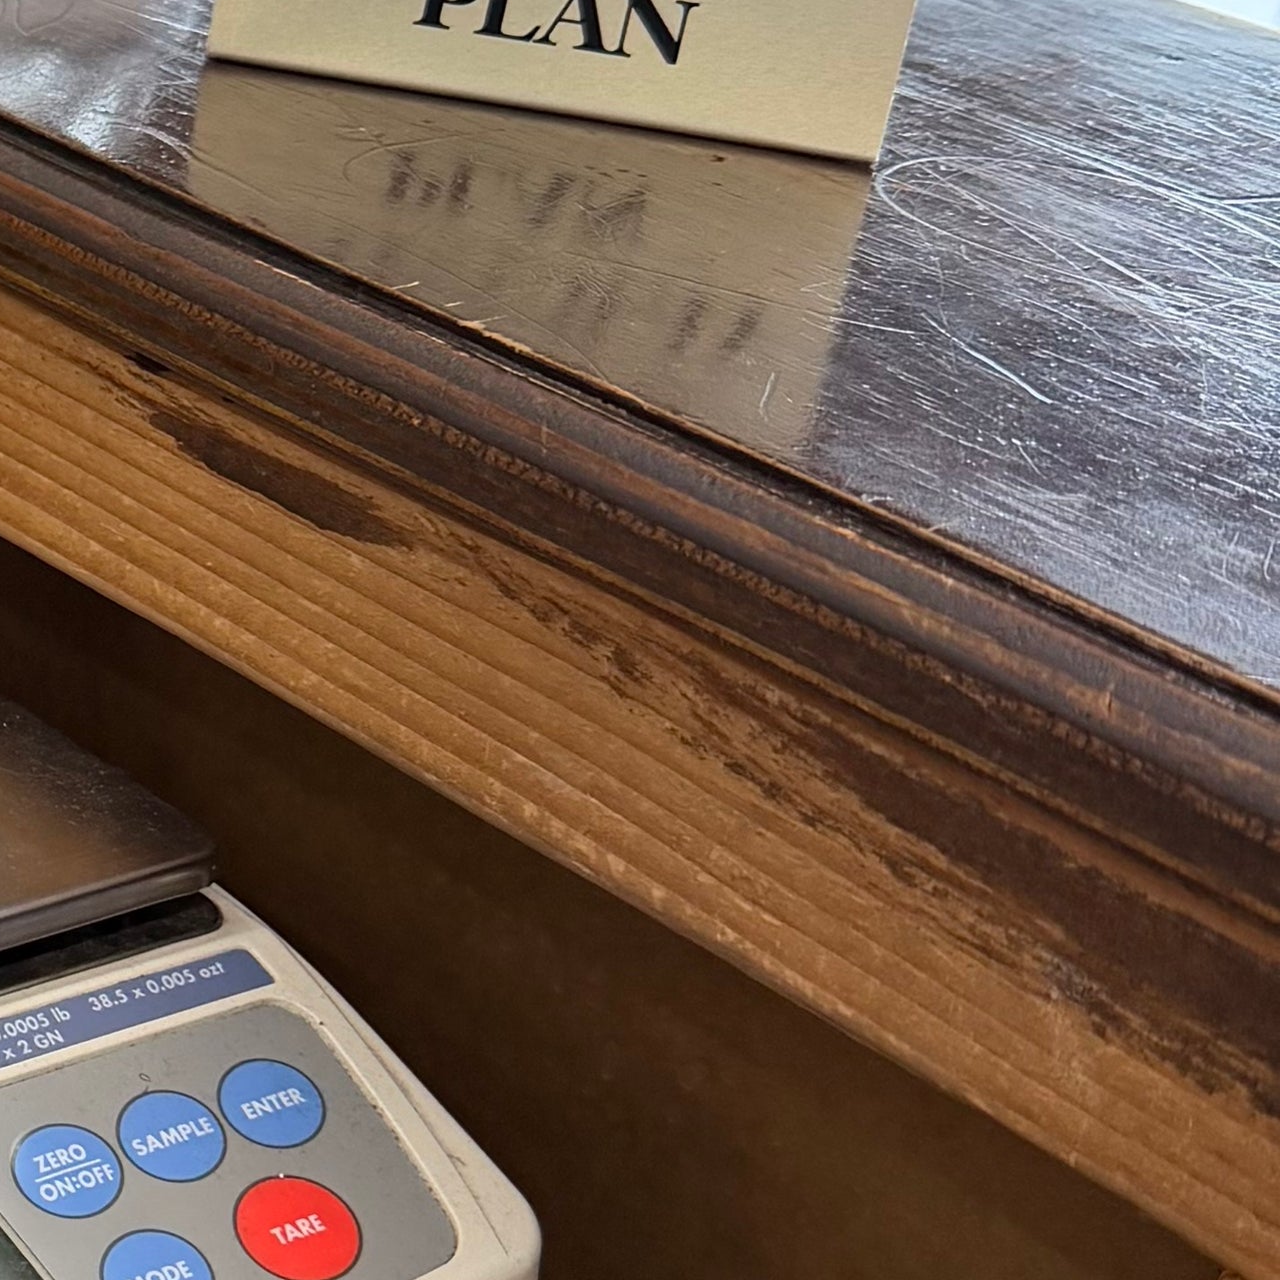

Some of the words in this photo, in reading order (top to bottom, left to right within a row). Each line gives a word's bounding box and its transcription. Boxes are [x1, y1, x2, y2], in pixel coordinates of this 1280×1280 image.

[52, 1006, 71, 1024] lb
[88, 988, 129, 1012] 38.5
[132, 985, 145, 1000] x
[148, 968, 196, 995] 0.005
[198, 961, 225, 978] ozt
[2, 1046, 16, 1060] x
[17, 1039, 33, 1056] 2
[34, 1029, 66, 1051] GN
[240, 1087, 308, 1121] ENTER
[131, 1117, 215, 1158] SAMPLE
[32, 1143, 88, 1175] ZERO
[39, 1162, 115, 1203] ON:OFF
[269, 1213, 328, 1246] TARE
